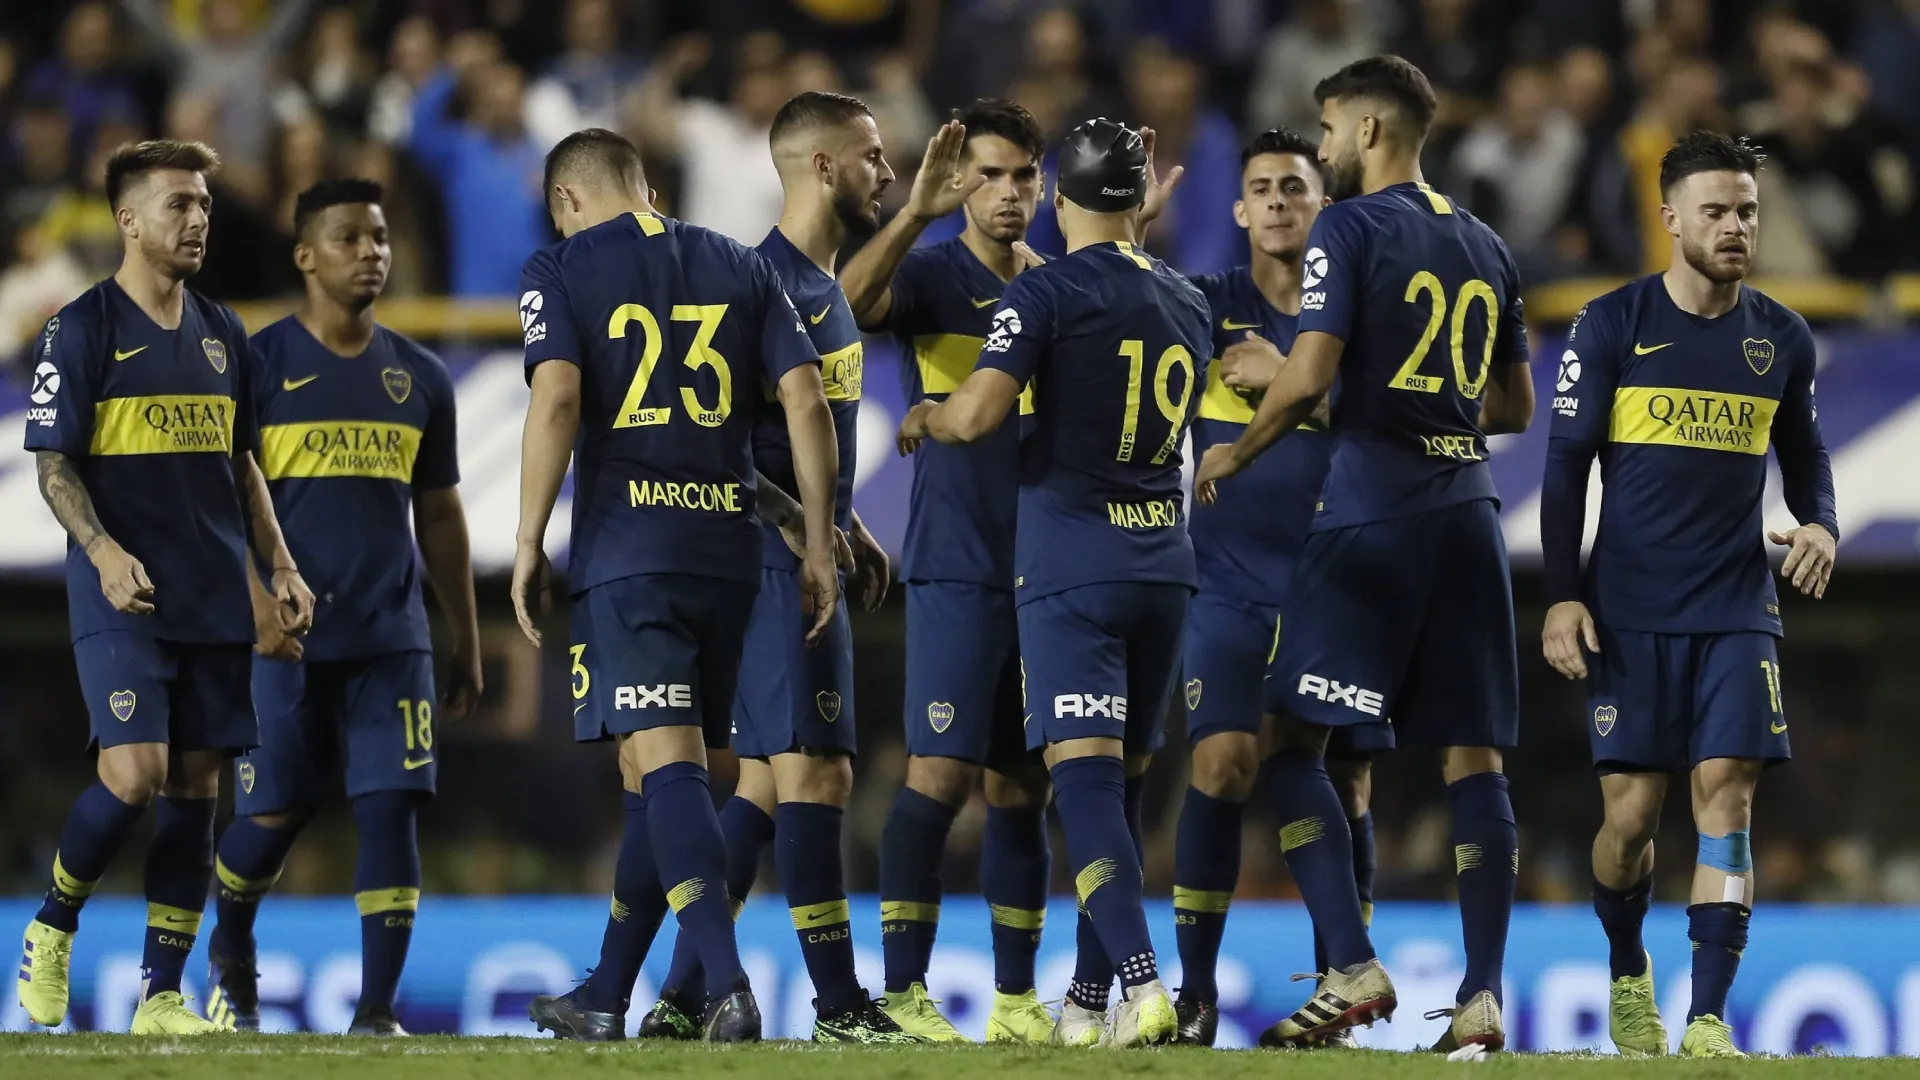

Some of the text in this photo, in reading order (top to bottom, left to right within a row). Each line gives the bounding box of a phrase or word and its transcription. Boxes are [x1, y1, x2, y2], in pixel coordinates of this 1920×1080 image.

[1388, 271, 1499, 399] 20
[608, 303, 732, 429] 23
[1748, 349, 1769, 359] CABJ
[832, 350, 862, 388] QATA
[1405, 377, 1429, 390] RUS
[1116, 340, 1194, 464] 19
[1648, 394, 1756, 429] QATAR
[628, 411, 656, 424] RUS
[699, 412, 724, 425] RUS
[304, 427, 402, 458] QATAR
[1120, 432, 1133, 459] RUS
[1160, 435, 1177, 460] RUS
[1420, 436, 1483, 461] LOPEZ
[1675, 425, 1753, 448] AIRWAYS
[329, 453, 400, 472] AIRWAYS
[628, 480, 742, 512] MARCONE
[1106, 499, 1176, 529] MAURO
[615, 684, 692, 710] AXE
[1054, 693, 1127, 722] AXE
[1298, 673, 1384, 716] AXE
[398, 699, 433, 752] 18
[808, 928, 849, 944] CABJ
